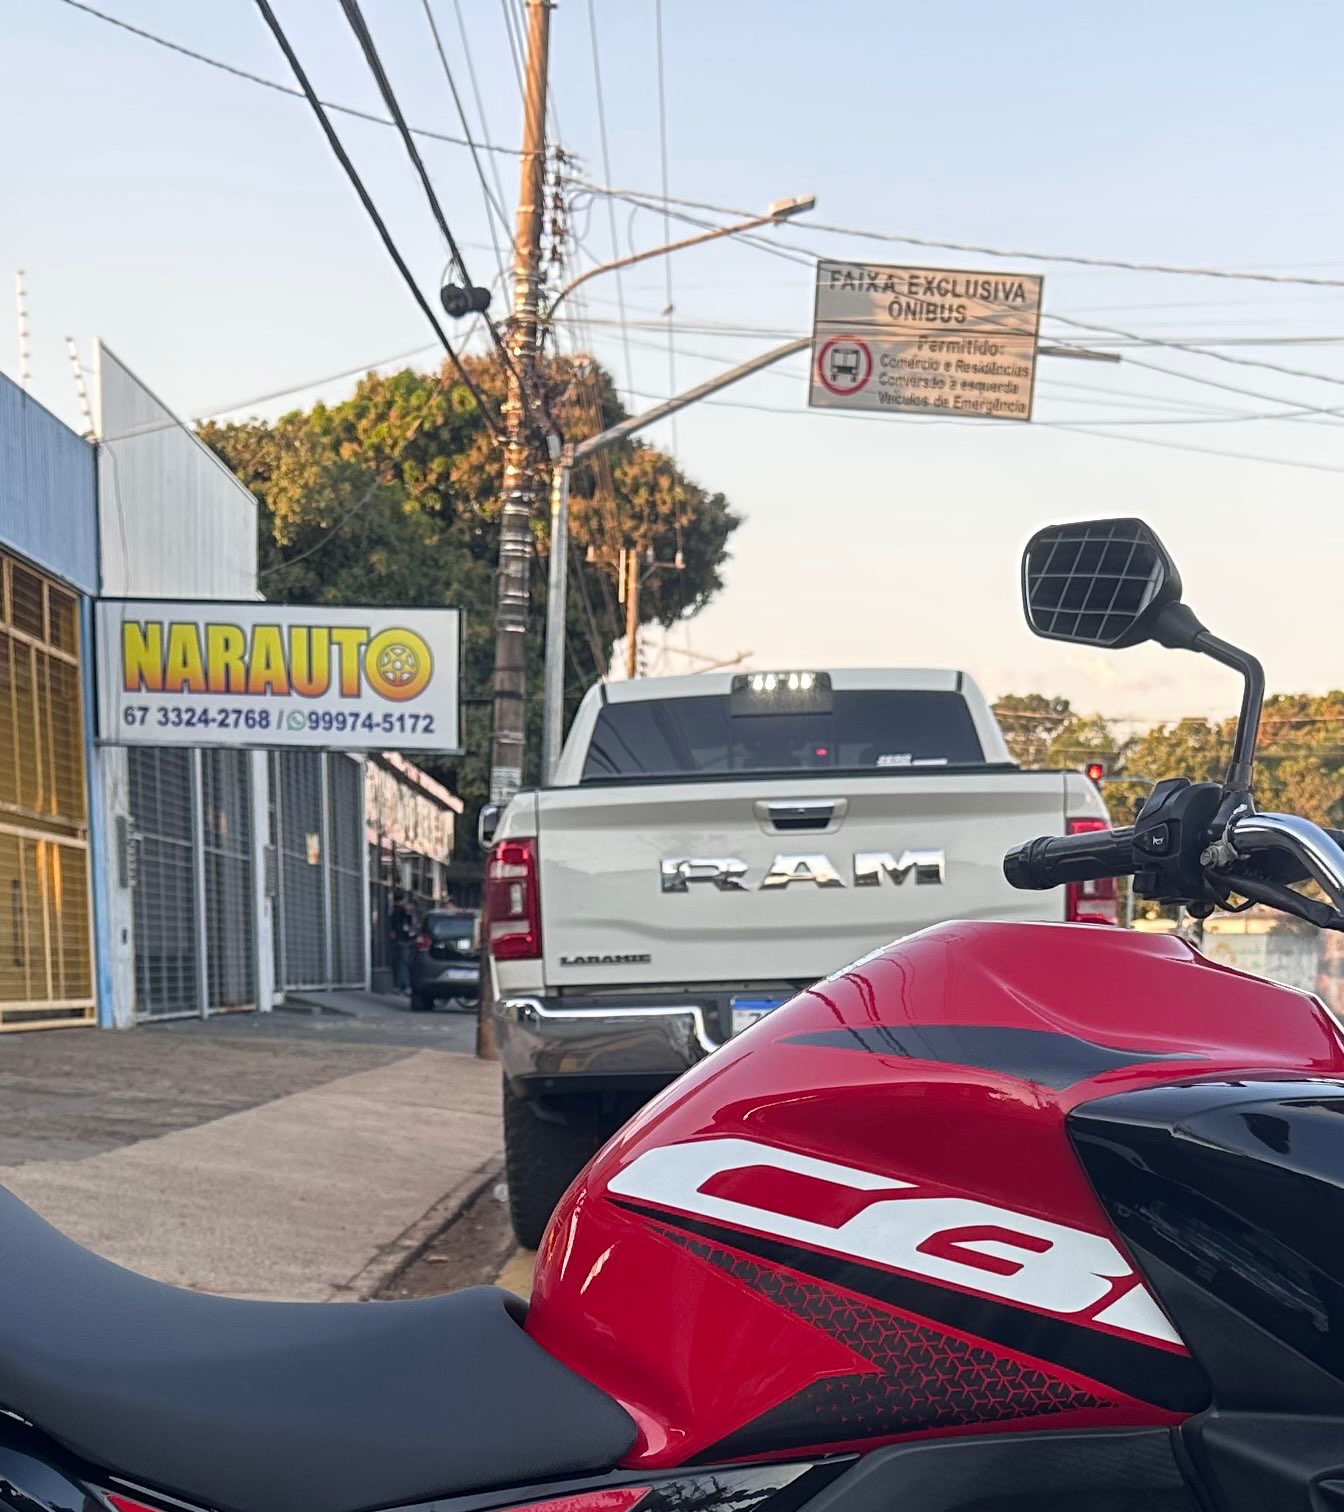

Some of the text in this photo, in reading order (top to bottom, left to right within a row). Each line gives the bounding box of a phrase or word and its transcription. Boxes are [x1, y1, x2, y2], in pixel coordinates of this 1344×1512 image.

[829, 270, 1027, 301] FAIXA EXCLUSIVA
[888, 297, 969, 324] ÔNIBUS
[122, 619, 434, 703] NARAUTO
[123, 706, 149, 727] 67
[156, 707, 271, 730] 3324-2768
[308, 710, 435, 734] 99974-5172
[659, 848, 947, 893] RAM
